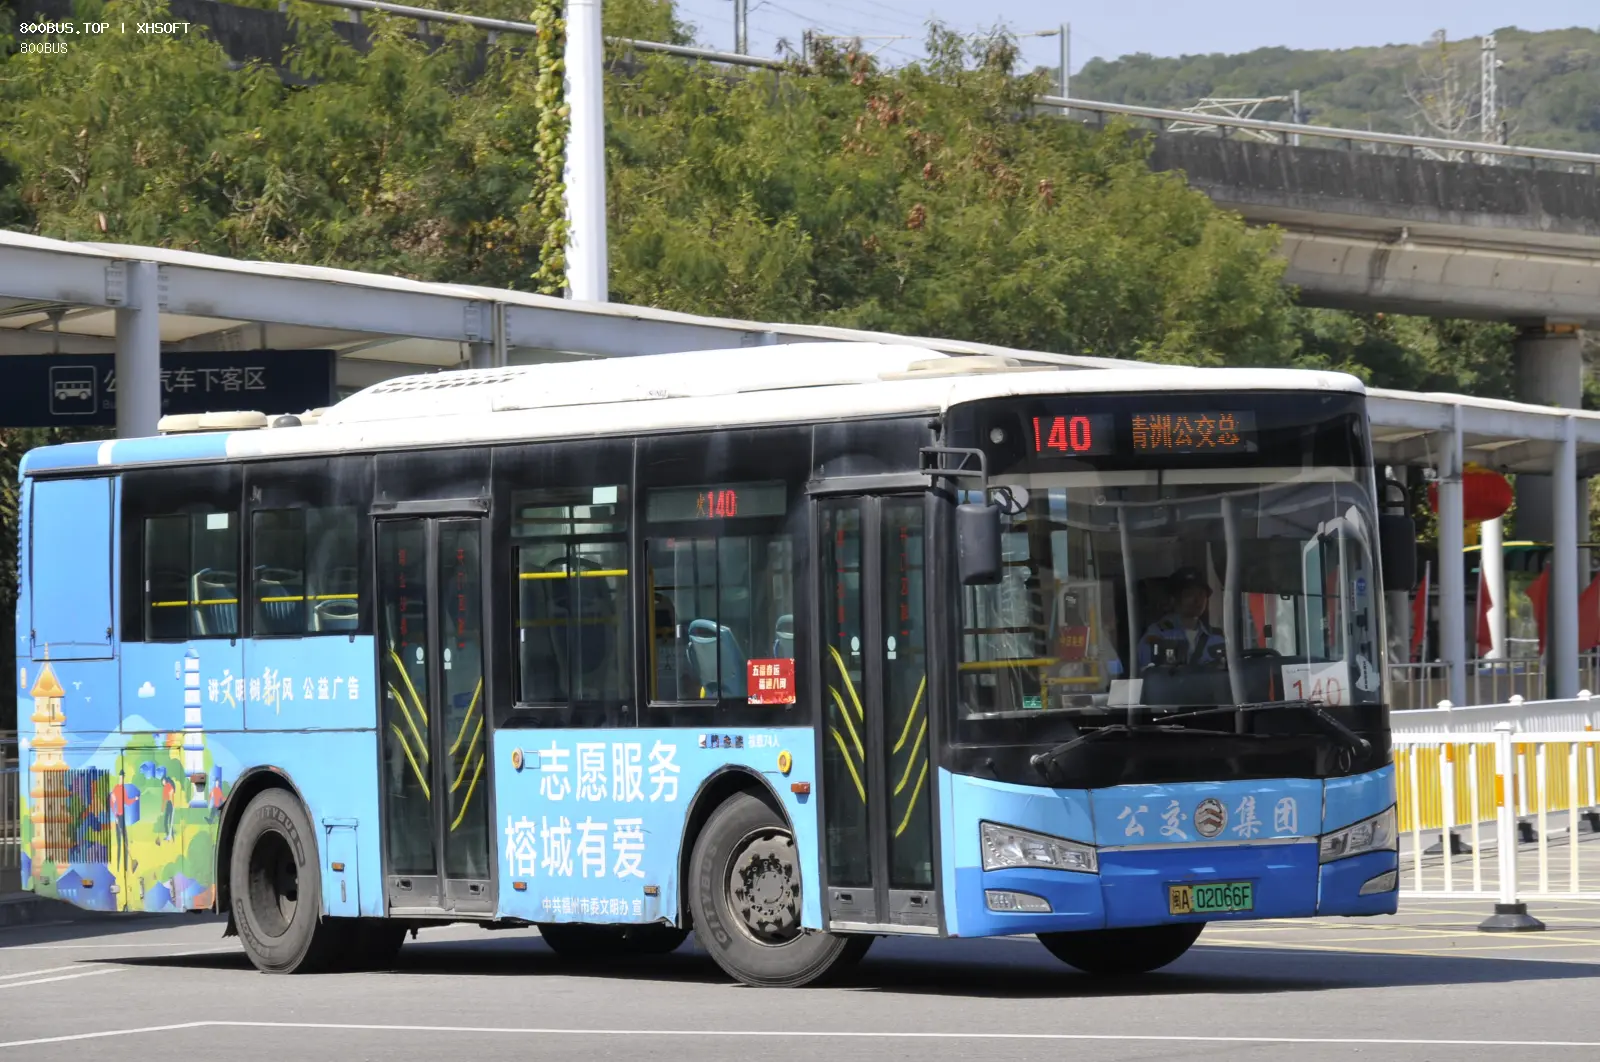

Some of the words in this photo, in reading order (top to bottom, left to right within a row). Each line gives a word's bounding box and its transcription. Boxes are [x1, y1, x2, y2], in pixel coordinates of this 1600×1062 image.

[103, 366, 267, 393] 公汽车下客区
[1032, 415, 1092, 452] 140
[303, 675, 360, 700] 公益广告
[539, 739, 682, 803] 志愿服务
[1117, 799, 1189, 840] 公交
[1231, 795, 1299, 839] 集团
[503, 815, 646, 879] 榕城有爱
[631, 898, 642, 916] 宣
